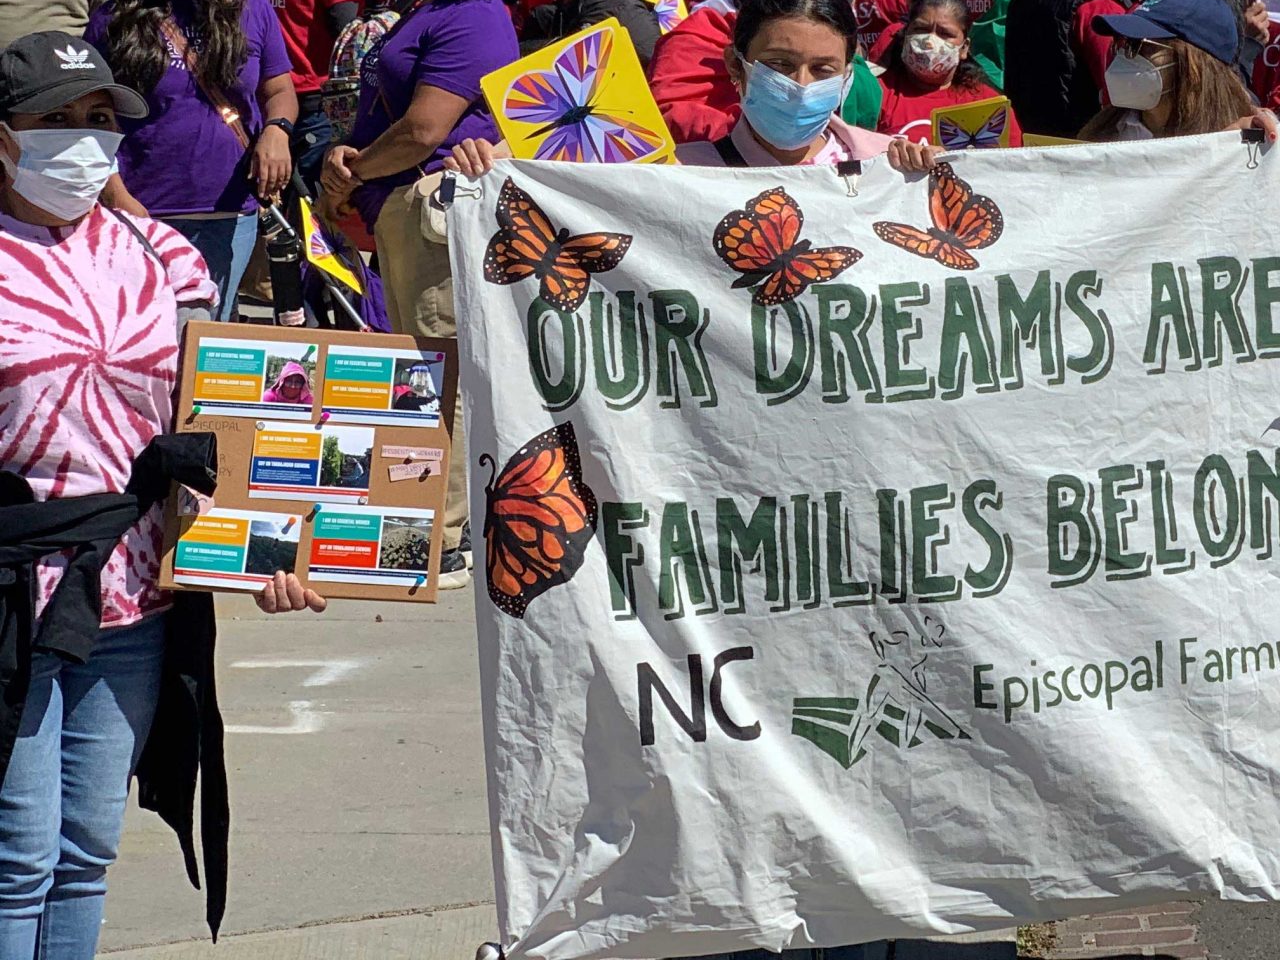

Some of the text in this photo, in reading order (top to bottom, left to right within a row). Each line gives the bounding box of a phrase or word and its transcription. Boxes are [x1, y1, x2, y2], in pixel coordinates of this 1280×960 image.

[60, 61, 96, 70] adidas
[526, 288, 719, 412] OUR
[750, 270, 1115, 406] DREAMS
[598, 478, 1013, 622] FAMILIES
[637, 646, 761, 745] NC
[973, 639, 1165, 722] Episcopal
